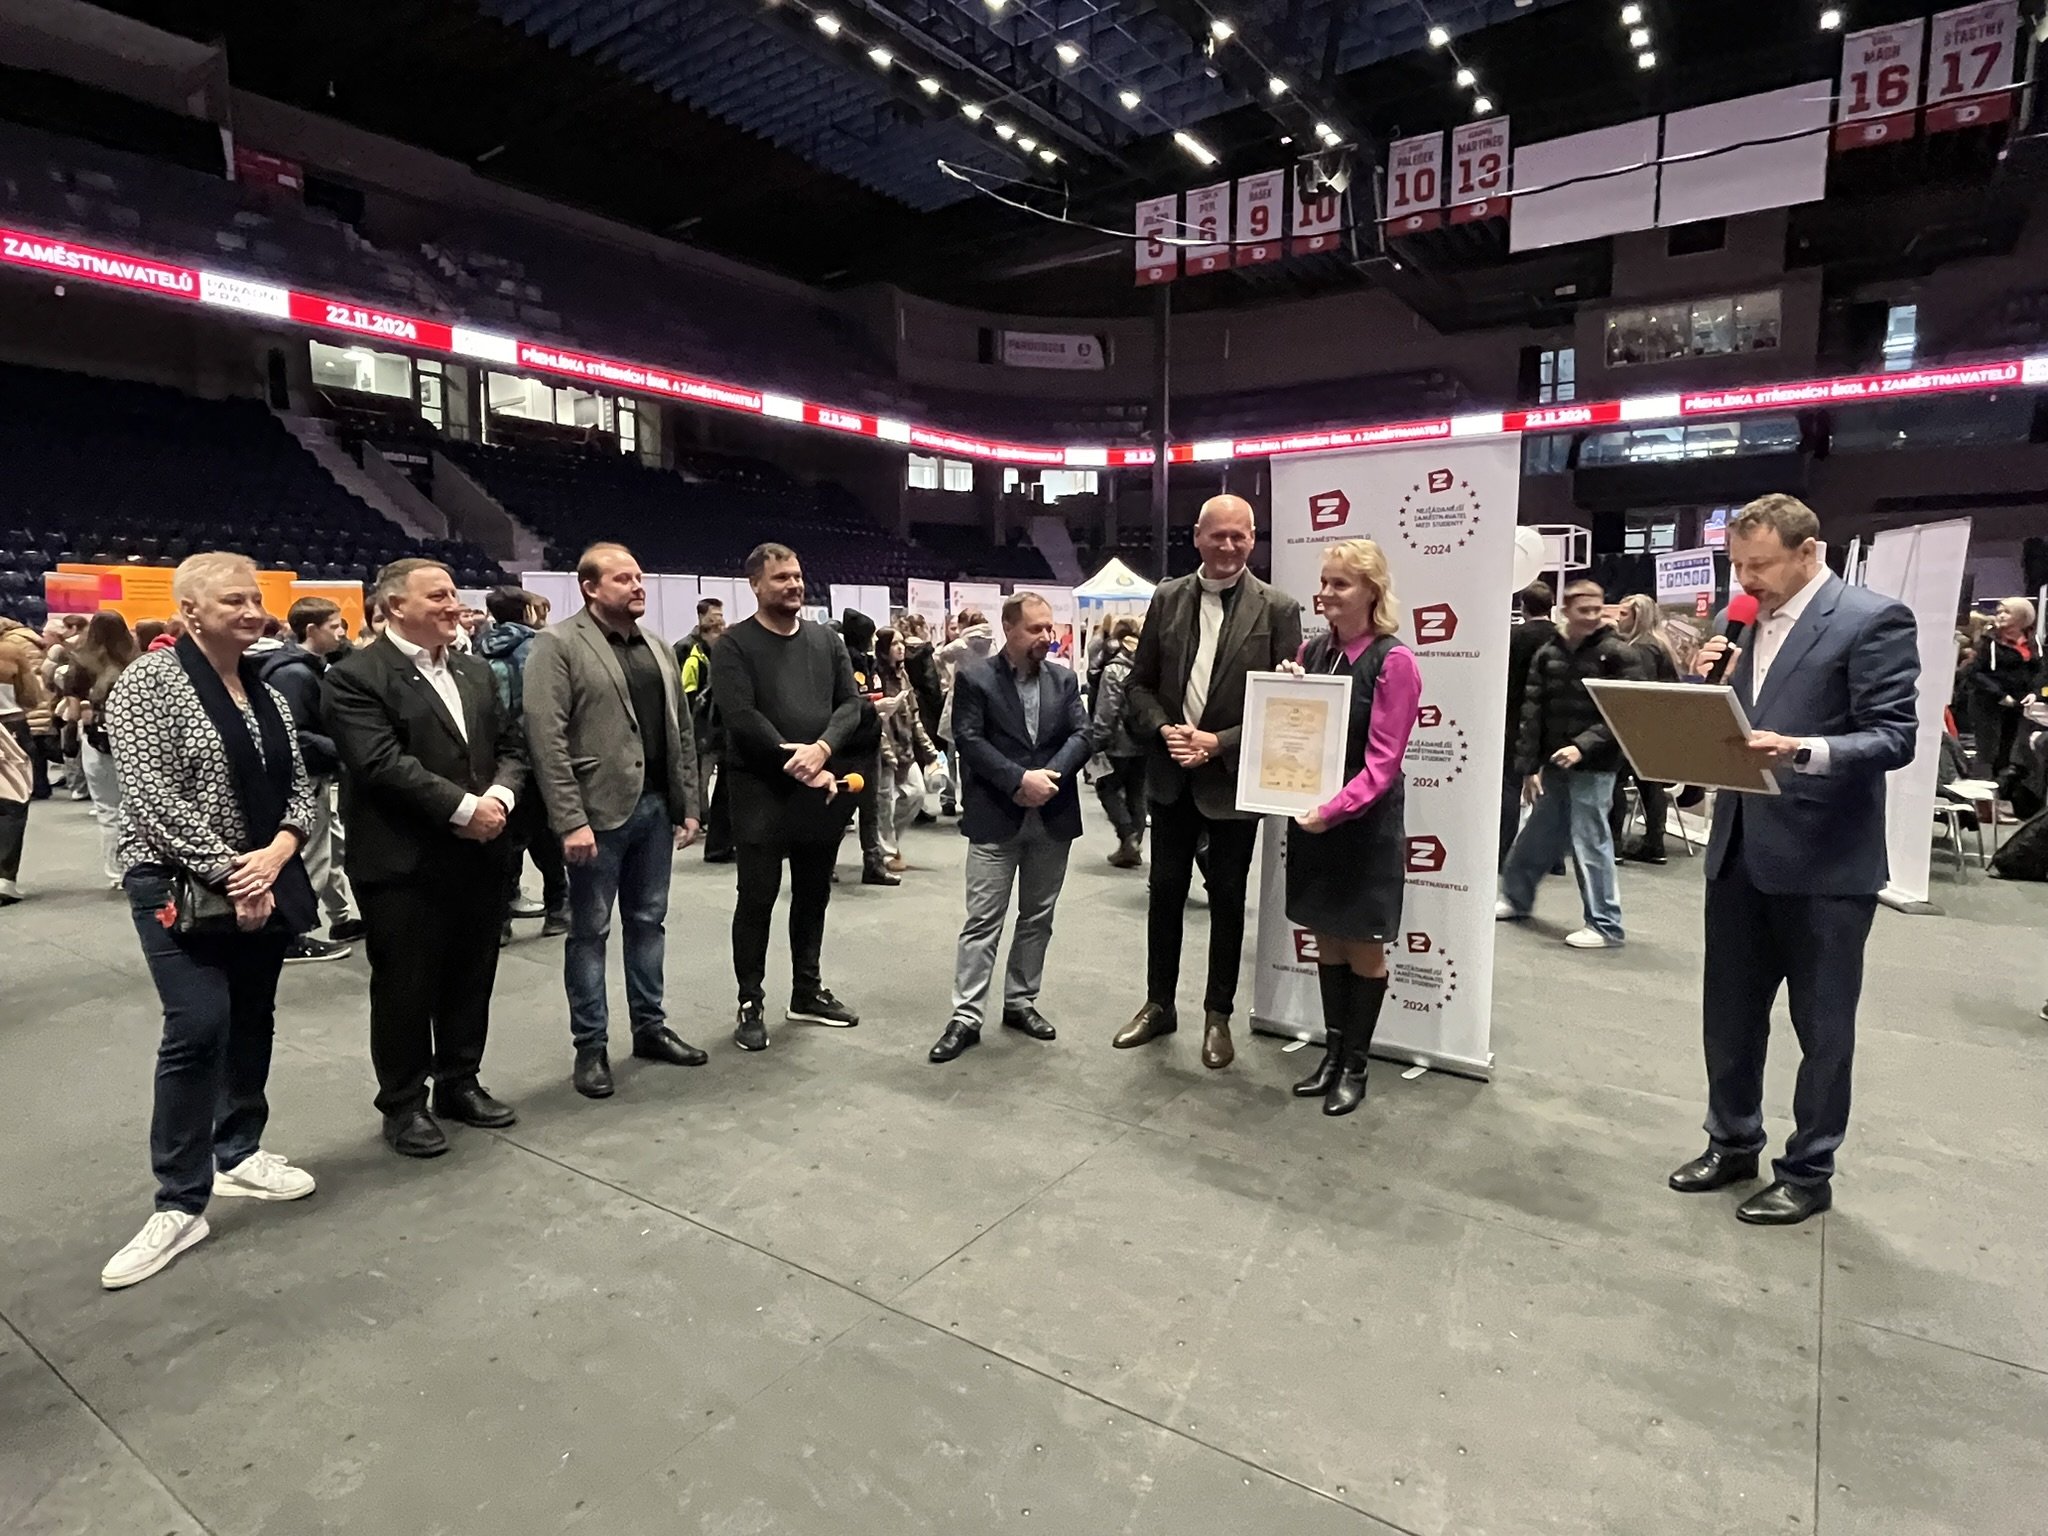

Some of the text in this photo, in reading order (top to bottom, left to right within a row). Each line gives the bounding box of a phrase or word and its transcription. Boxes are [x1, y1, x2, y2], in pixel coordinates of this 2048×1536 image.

[1940, 41, 2003, 97] 17
[1848, 64, 1910, 114] 16
[1394, 168, 1435, 207] 10
[1458, 153, 1501, 194] 13
[1250, 205, 1269, 236] 9
[1148, 228, 1164, 258] 5
[3, 237, 193, 291] ZAMĚSTNAVATELŮ
[326, 304, 416, 340] 22.11.2024
[1831, 378, 1866, 396] ŠKOL
[1868, 381, 1879, 393] A
[1882, 365, 2017, 391] ZAMĚSTNAVATELŮ
[1423, 544, 1451, 555] 2024
[1414, 650, 1480, 658] AMĚSTNAVATELŮ
[1412, 777, 1440, 788] 2024
[1405, 878, 1469, 892] AMĚSTNAVATELŮ
[1403, 999, 1430, 1012] 2024
